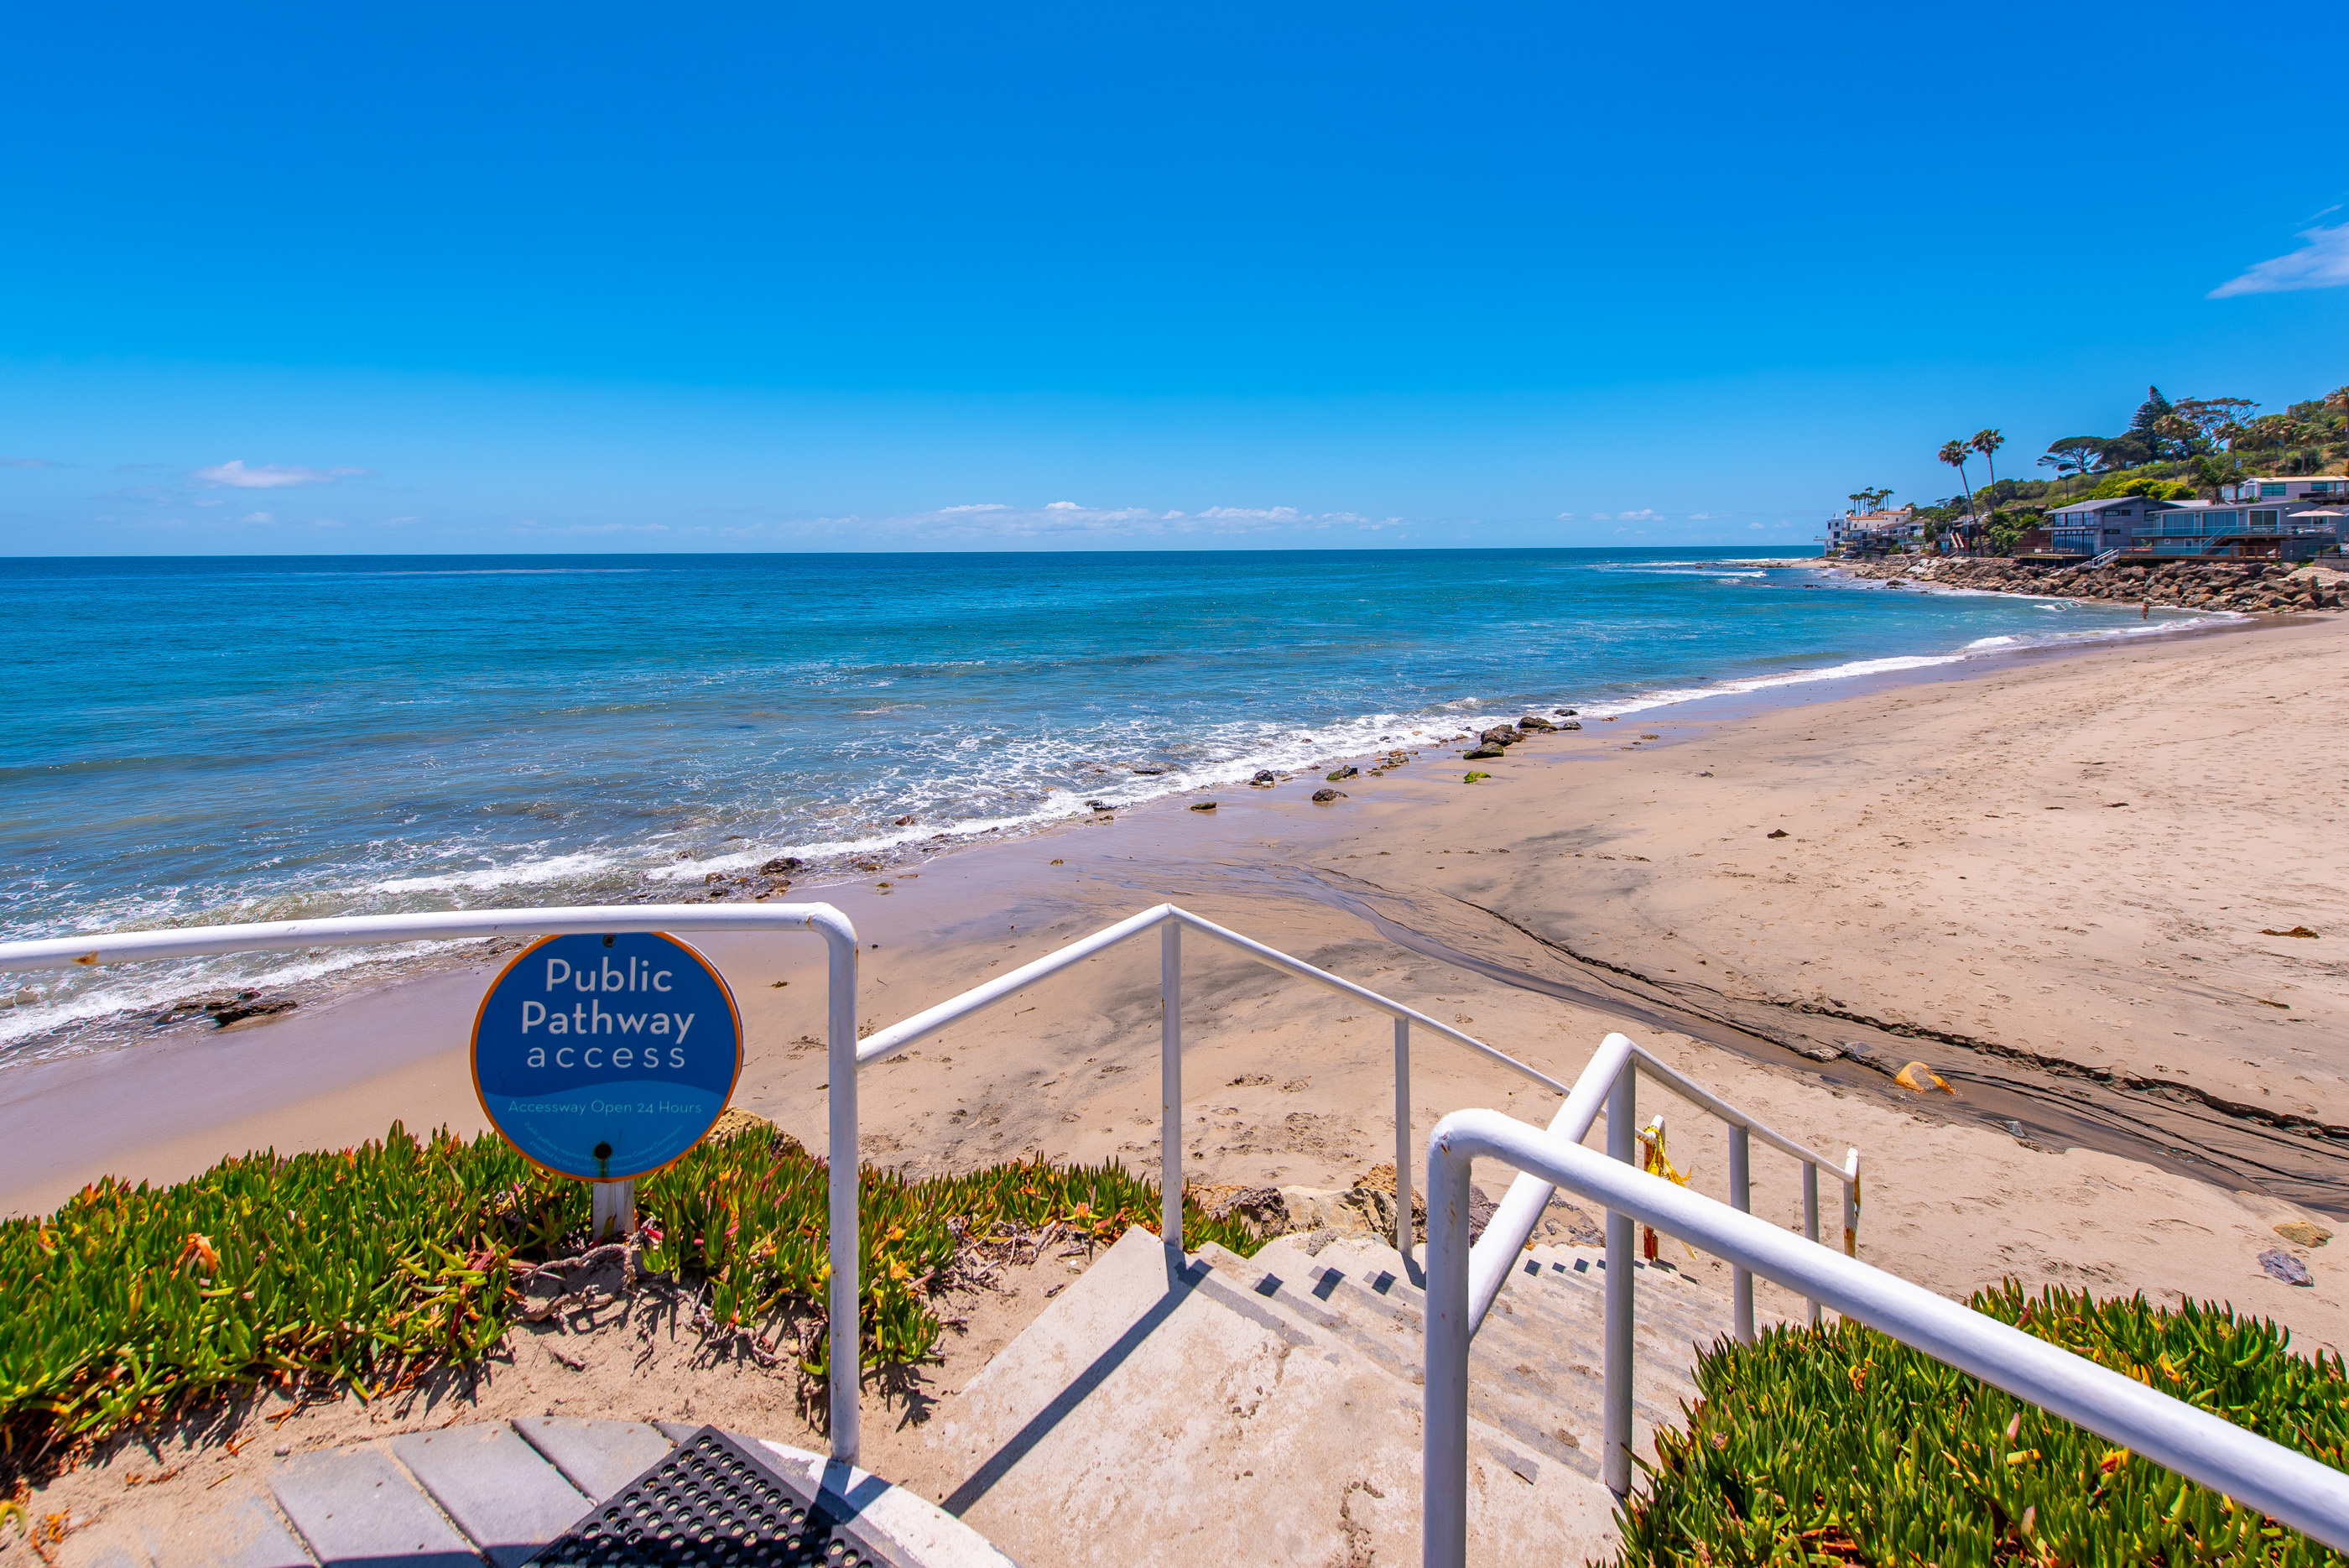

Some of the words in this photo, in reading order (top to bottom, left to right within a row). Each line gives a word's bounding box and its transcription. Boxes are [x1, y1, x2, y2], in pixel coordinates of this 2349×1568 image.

[546, 956, 673, 992] Public
[521, 999, 695, 1044] Pathway
[526, 1047, 685, 1069] access
[508, 1100, 586, 1116] Accessway
[591, 1099, 632, 1117] Open
[637, 1102, 654, 1114] 24
[659, 1100, 702, 1114] Hours
